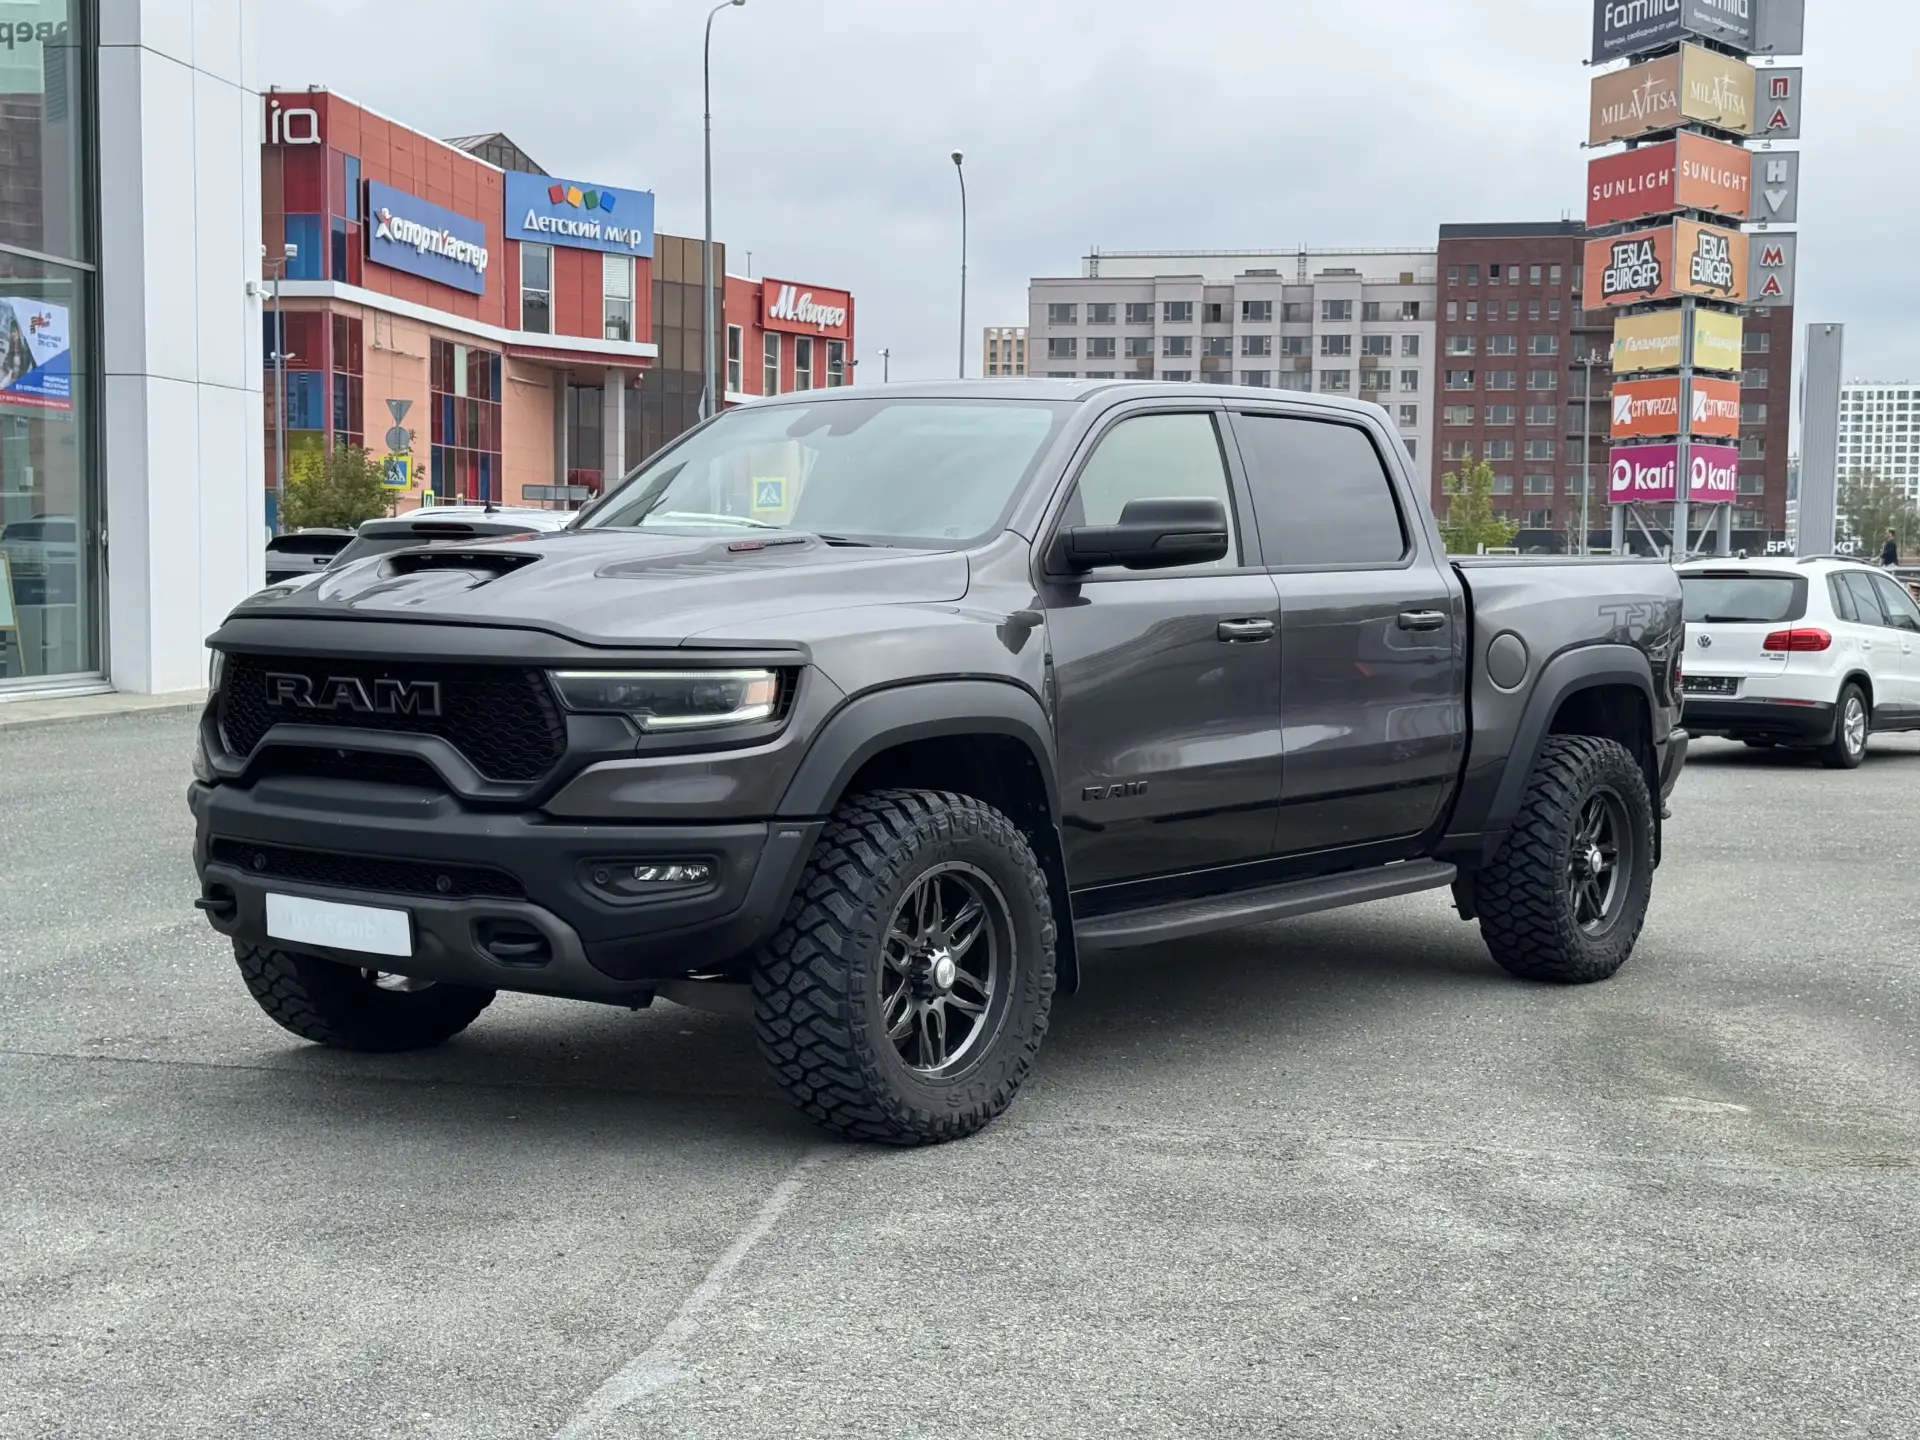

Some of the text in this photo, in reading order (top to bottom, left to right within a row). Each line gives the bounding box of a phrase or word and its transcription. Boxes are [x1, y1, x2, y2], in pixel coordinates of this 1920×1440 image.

[1592, 167, 1677, 201] SUNLIGH
[1682, 159, 1748, 192] SUNLIGHT
[523, 208, 642, 250] Детский мир
[1612, 240, 1653, 269] TESLA
[1698, 234, 1728, 263] TESLA
[1603, 262, 1660, 294] BURGER
[1690, 256, 1732, 288] BURGER
[1634, 461, 1675, 490] kari
[1707, 462, 1736, 491] kari
[265, 672, 442, 716] RAM
[1081, 781, 1149, 802] RAM
